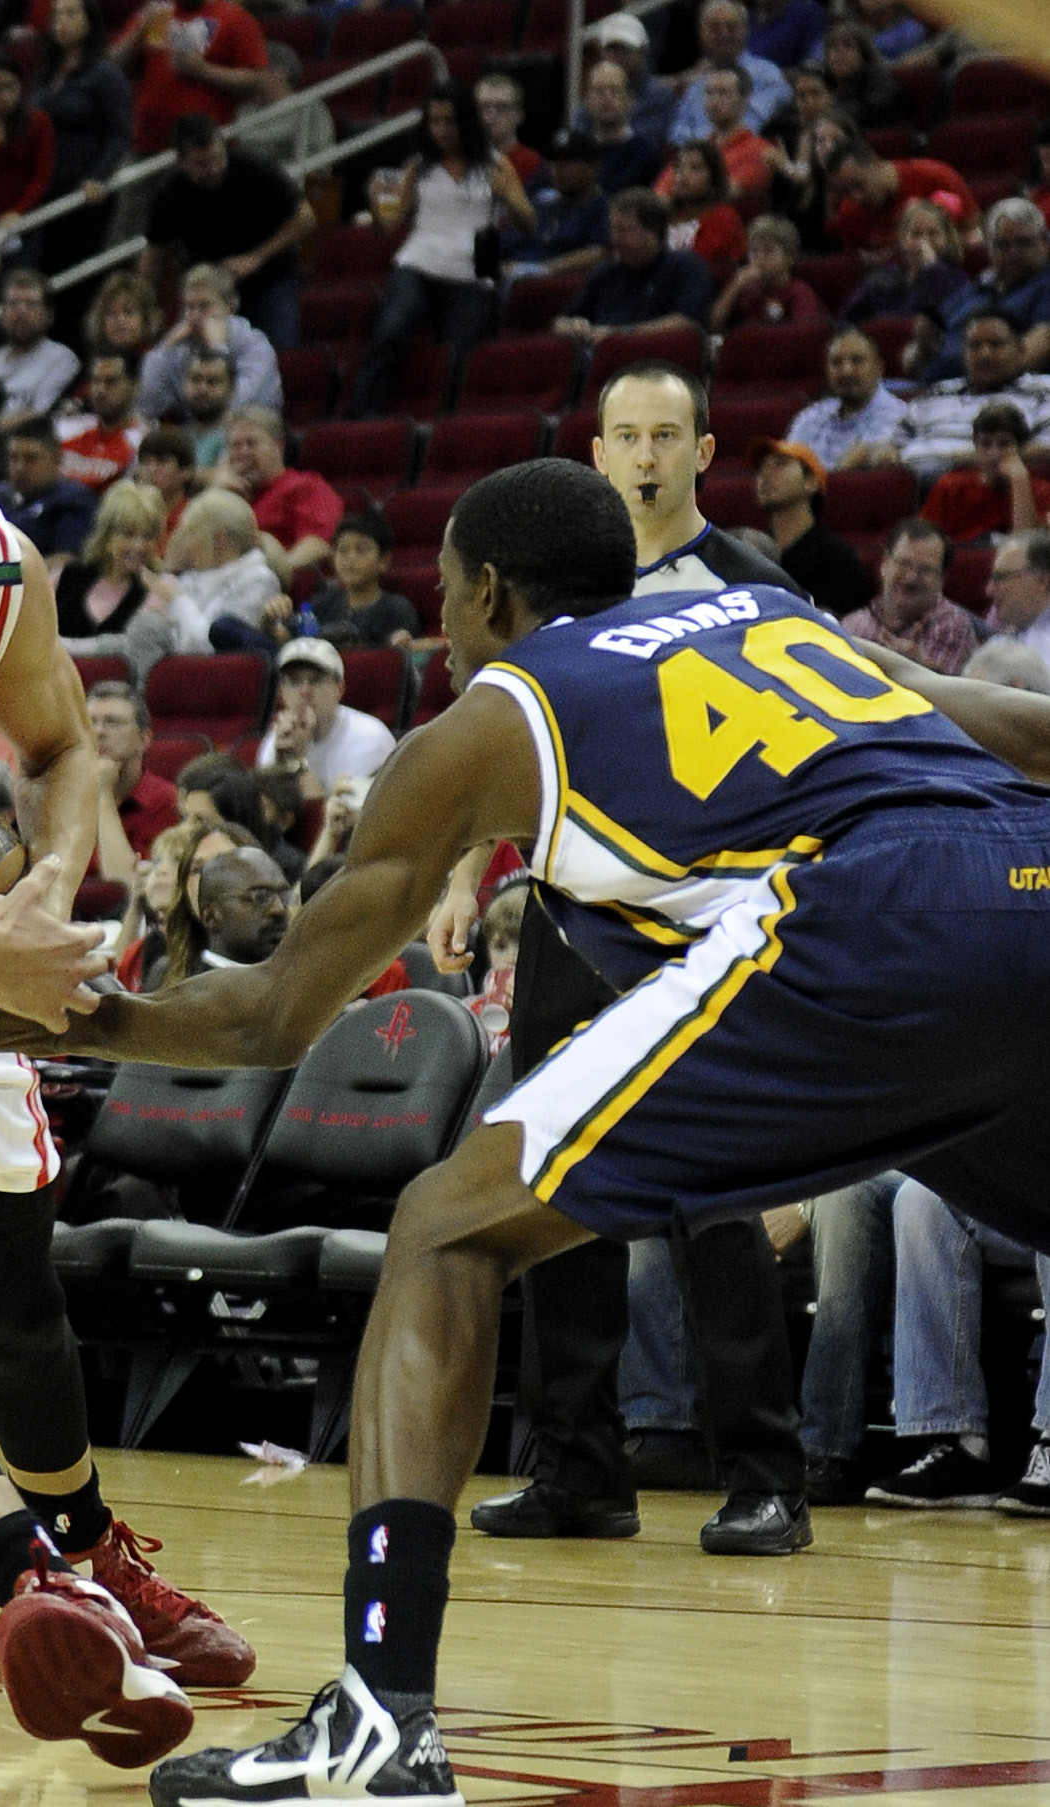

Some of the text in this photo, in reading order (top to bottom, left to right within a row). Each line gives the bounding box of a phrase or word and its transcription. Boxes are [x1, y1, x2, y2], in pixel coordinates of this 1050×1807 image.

[589, 590, 761, 659] EVANS
[657, 616, 934, 801] 40
[1009, 866, 1050, 891] UTA
